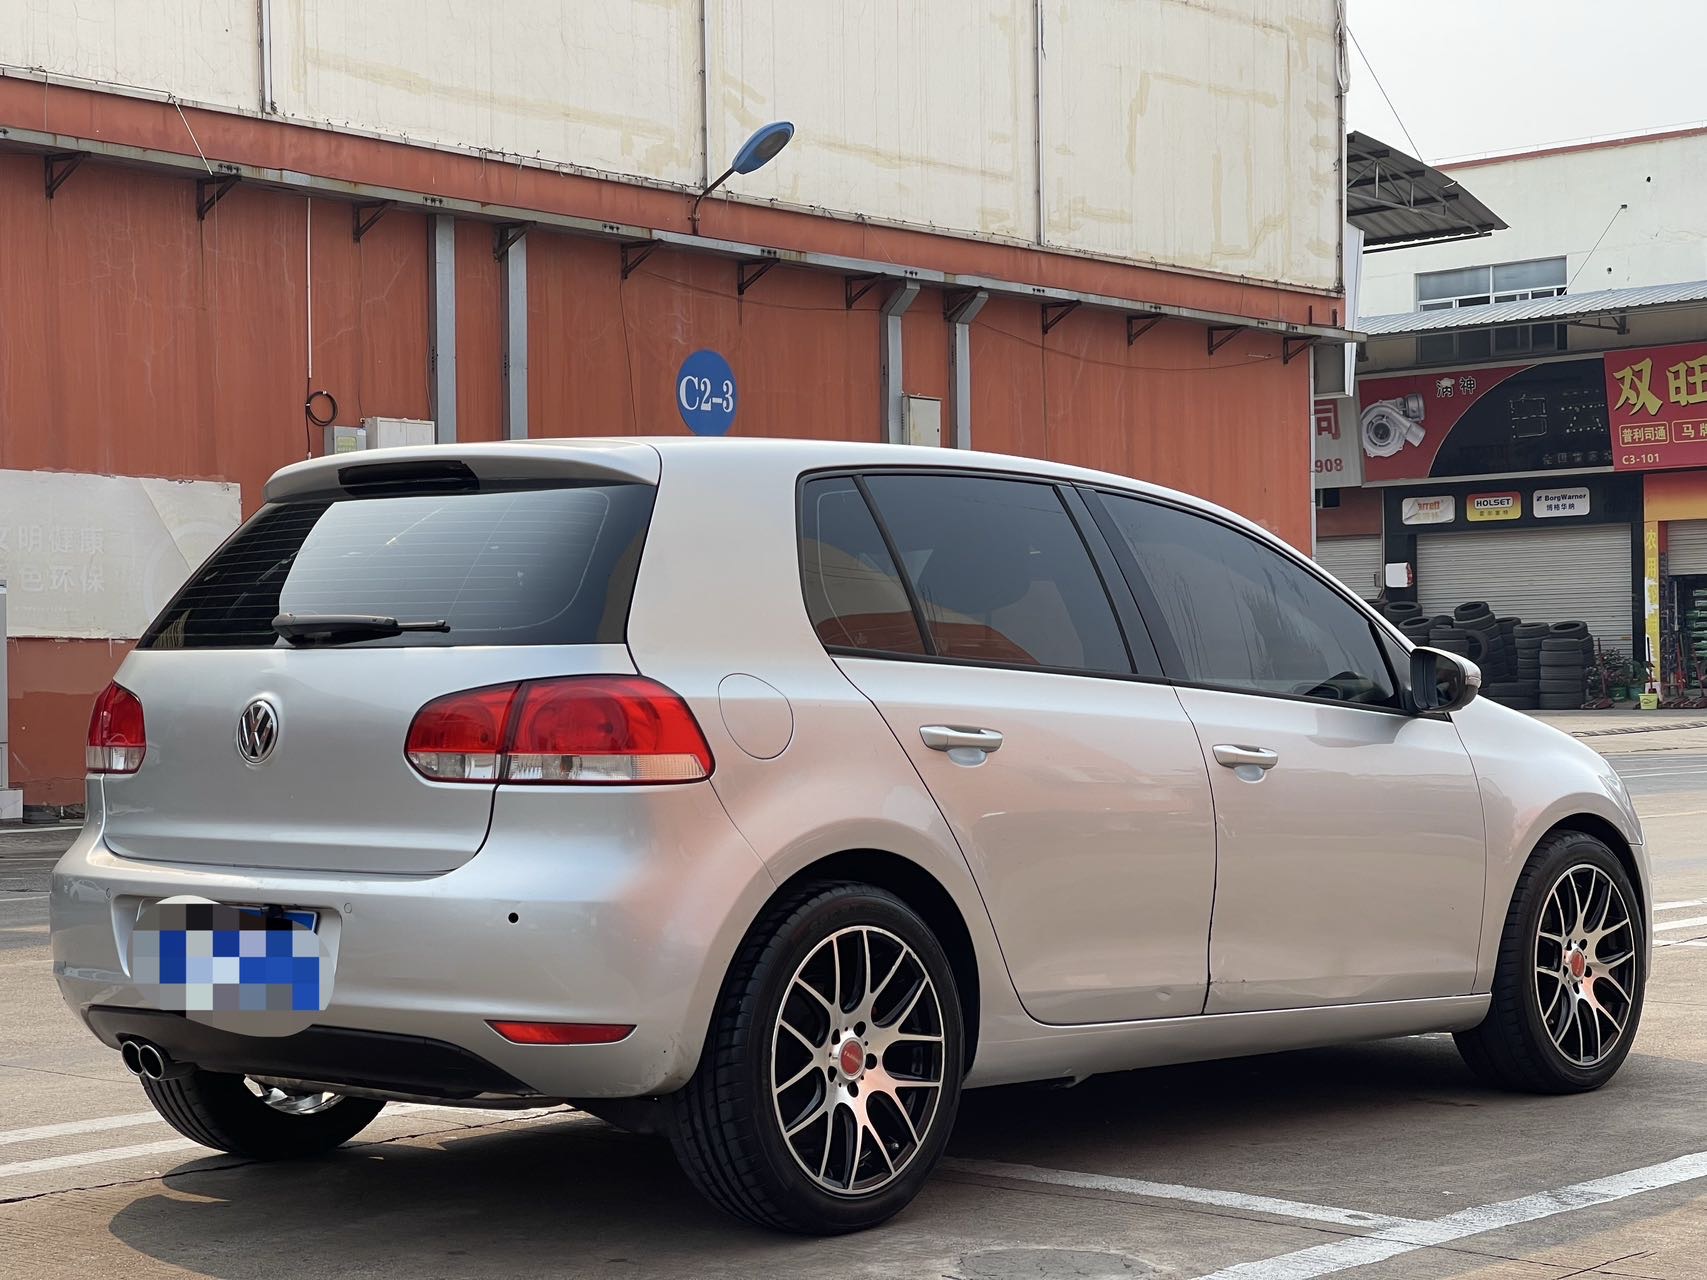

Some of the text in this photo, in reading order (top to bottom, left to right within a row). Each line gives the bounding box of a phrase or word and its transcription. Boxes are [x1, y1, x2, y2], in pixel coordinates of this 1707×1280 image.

[679, 375, 734, 413] C2-3
[1621, 426, 1667, 443] 普利司通
[1622, 453, 1660, 465] C3-101
[1476, 498, 1511, 507] HOLSET
[1544, 493, 1587, 502] BorgWarner
[0, 564, 105, 593] 色环保
